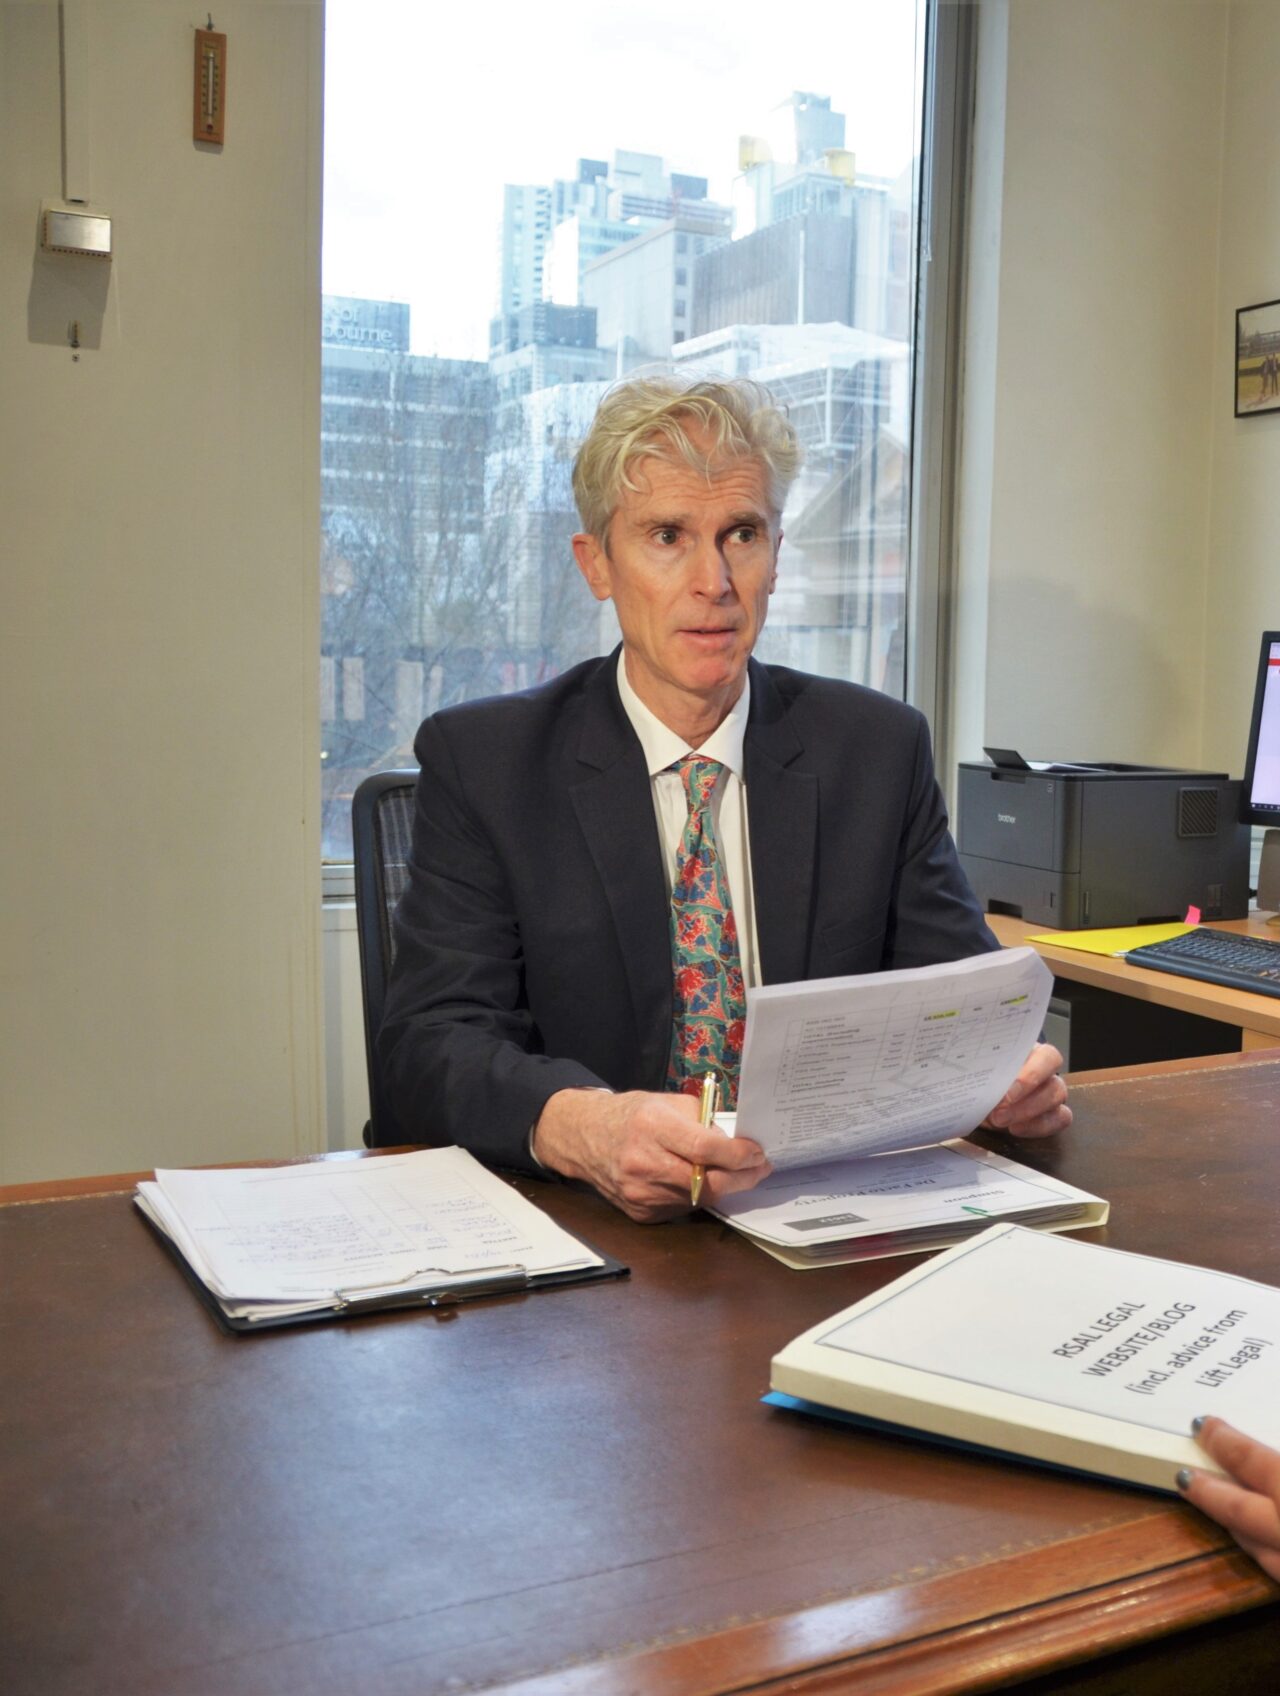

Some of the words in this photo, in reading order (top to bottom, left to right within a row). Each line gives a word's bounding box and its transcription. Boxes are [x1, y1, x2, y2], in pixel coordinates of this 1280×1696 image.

[1052, 1327, 1103, 1359] RSAL
[1096, 1301, 1147, 1333] LEGAL
[1081, 1301, 1196, 1378] WEBSITE/BLOG
[1124, 1369, 1175, 1396] (incl.
[1167, 1332, 1217, 1370] advice
[1206, 1308, 1248, 1336] from
[1195, 1367, 1233, 1389] Lift
[1222, 1336, 1275, 1371] Legal)
